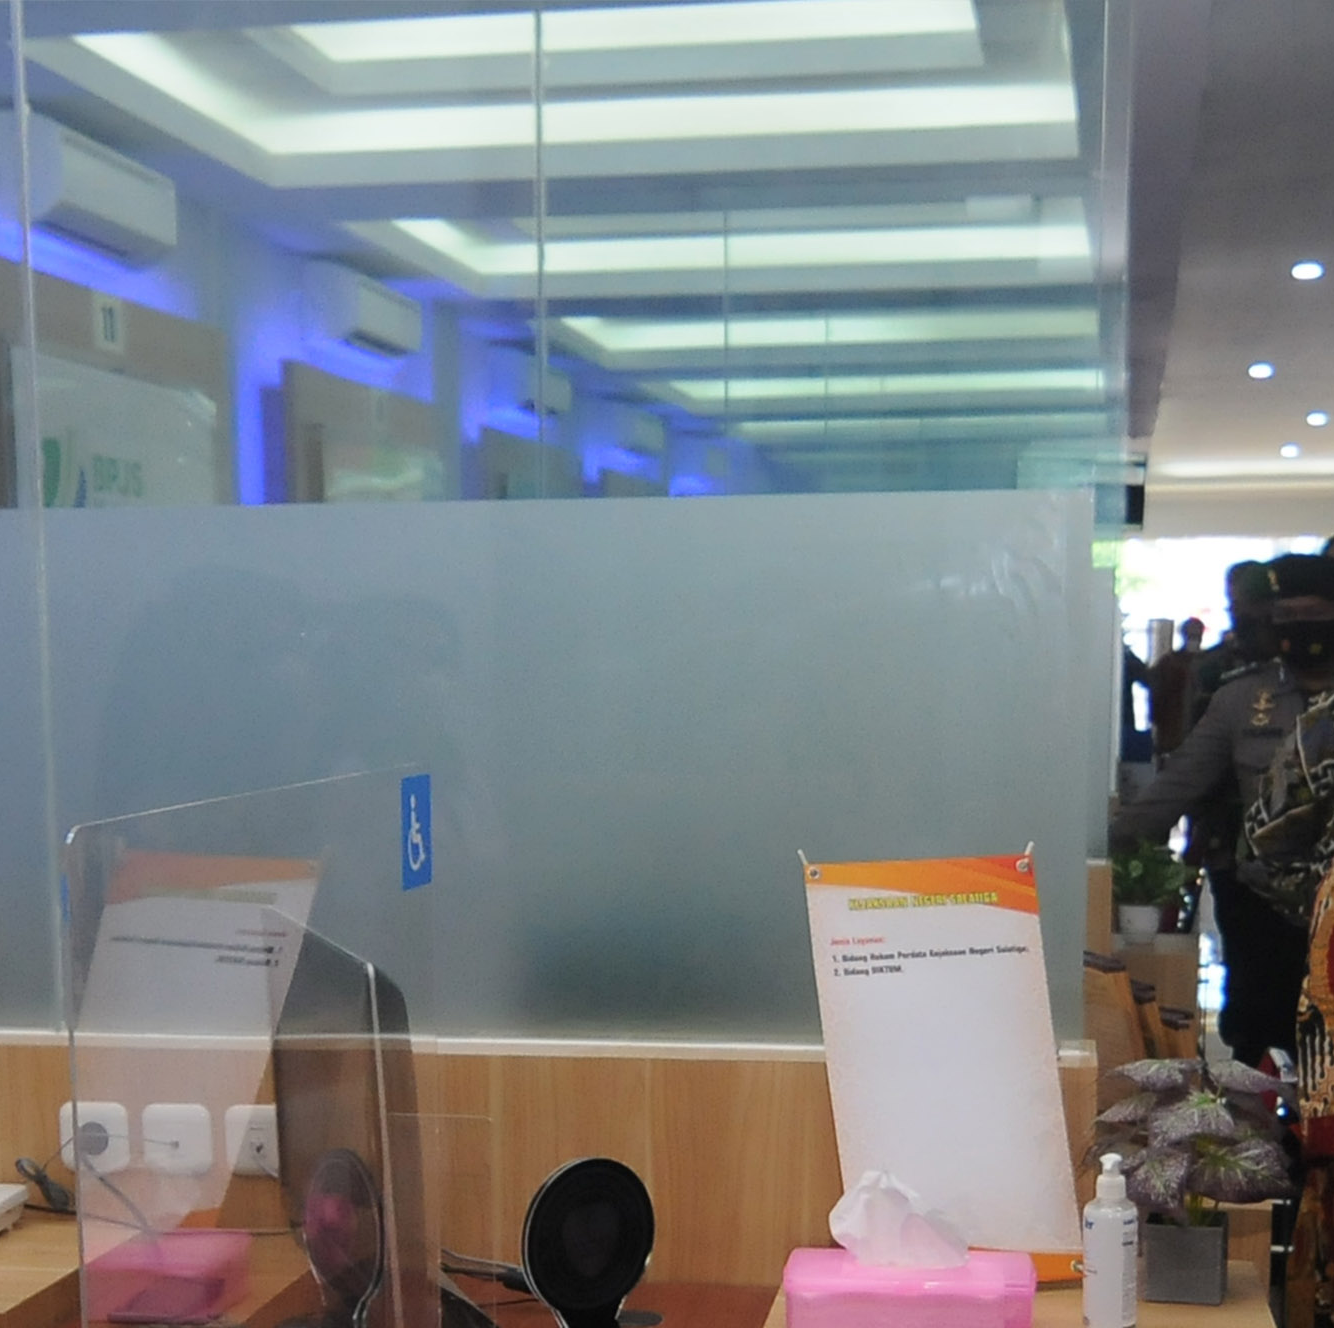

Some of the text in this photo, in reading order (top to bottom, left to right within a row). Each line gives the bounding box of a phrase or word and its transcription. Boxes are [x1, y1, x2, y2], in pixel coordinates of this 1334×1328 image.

[101, 307, 116, 343] 11
[91, 453, 146, 498] BPJS
[949, 891, 998, 906] SALATIGA
[842, 954, 868, 963] Bidang
[843, 967, 870, 977] Bidang
